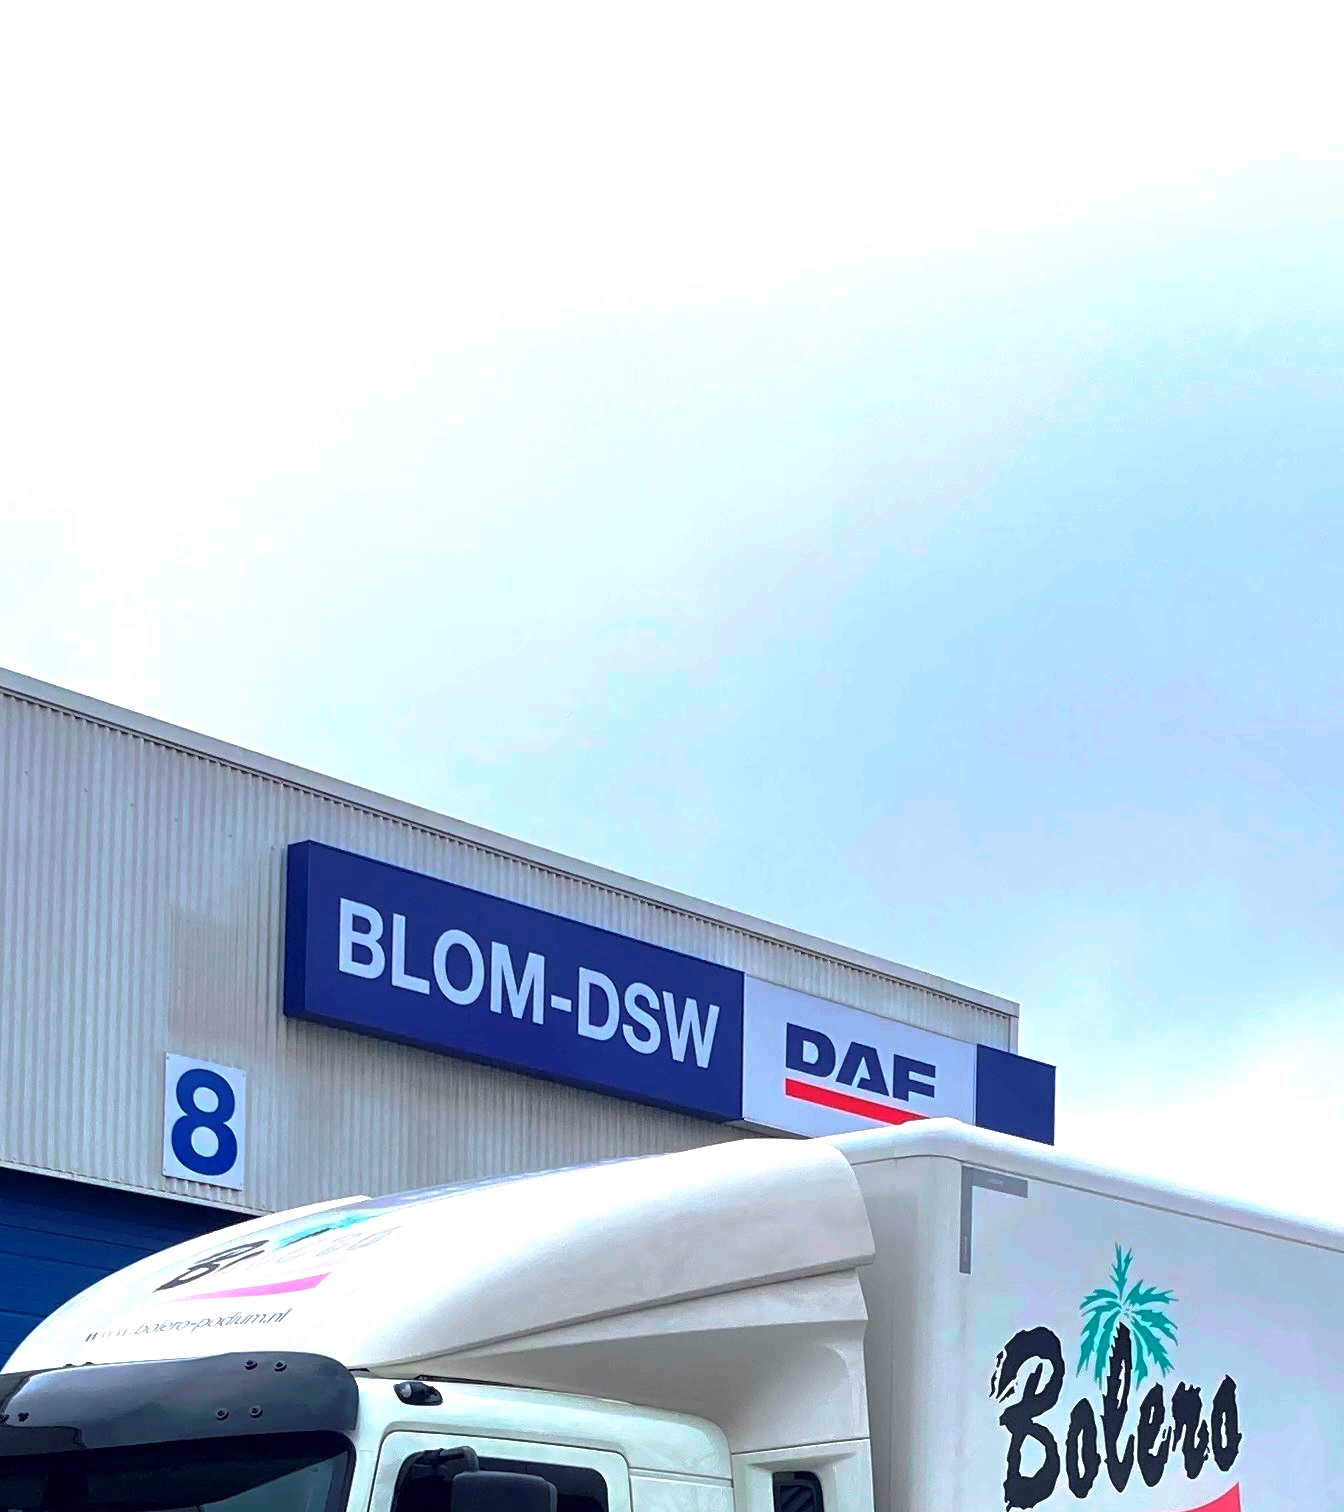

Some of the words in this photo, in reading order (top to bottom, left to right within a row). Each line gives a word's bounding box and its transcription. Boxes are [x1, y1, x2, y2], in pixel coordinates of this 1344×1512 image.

[338, 897, 721, 1070] BLOM-DSW
[785, 1022, 937, 1102] DAF
[171, 1068, 238, 1176] 8
